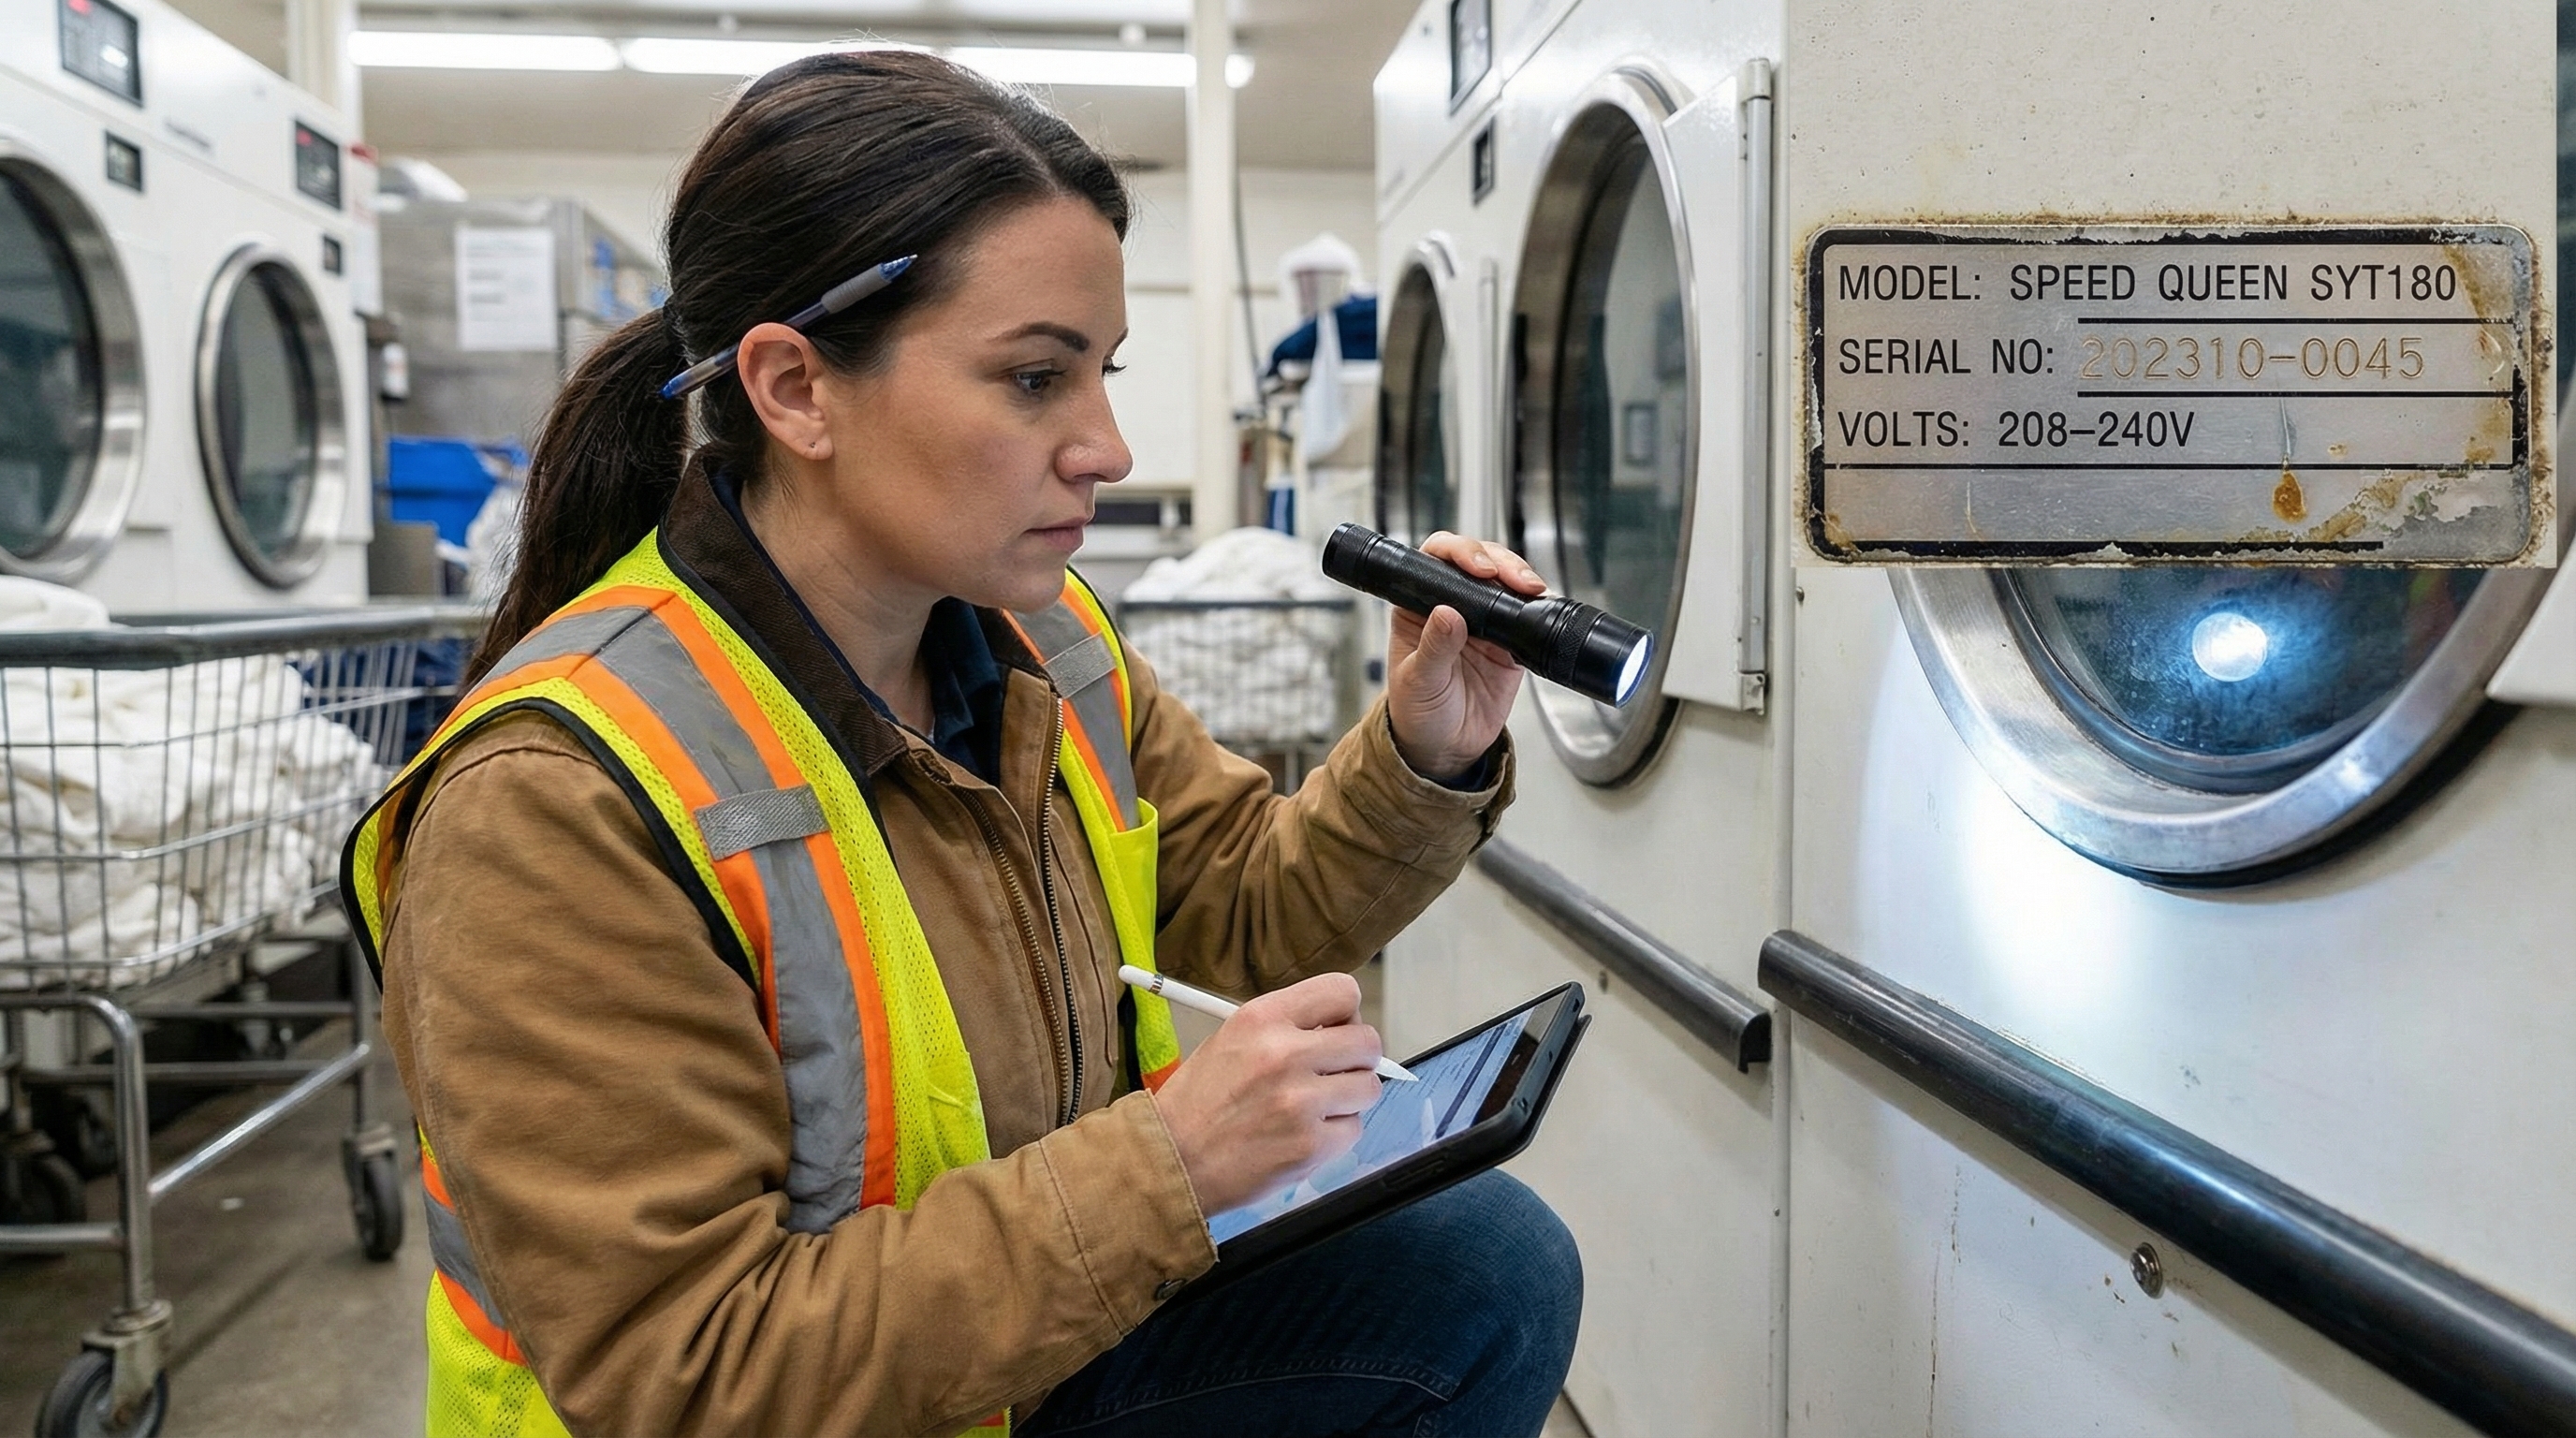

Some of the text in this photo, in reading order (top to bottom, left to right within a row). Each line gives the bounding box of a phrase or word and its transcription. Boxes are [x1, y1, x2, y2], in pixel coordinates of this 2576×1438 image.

[1839, 263, 2456, 303] MODEL: SPEED QUEEN SYT180
[1839, 336, 2425, 380] SERIAL NO: 202310-0045
[1837, 410, 2195, 448] VOLTS: 208-240V
